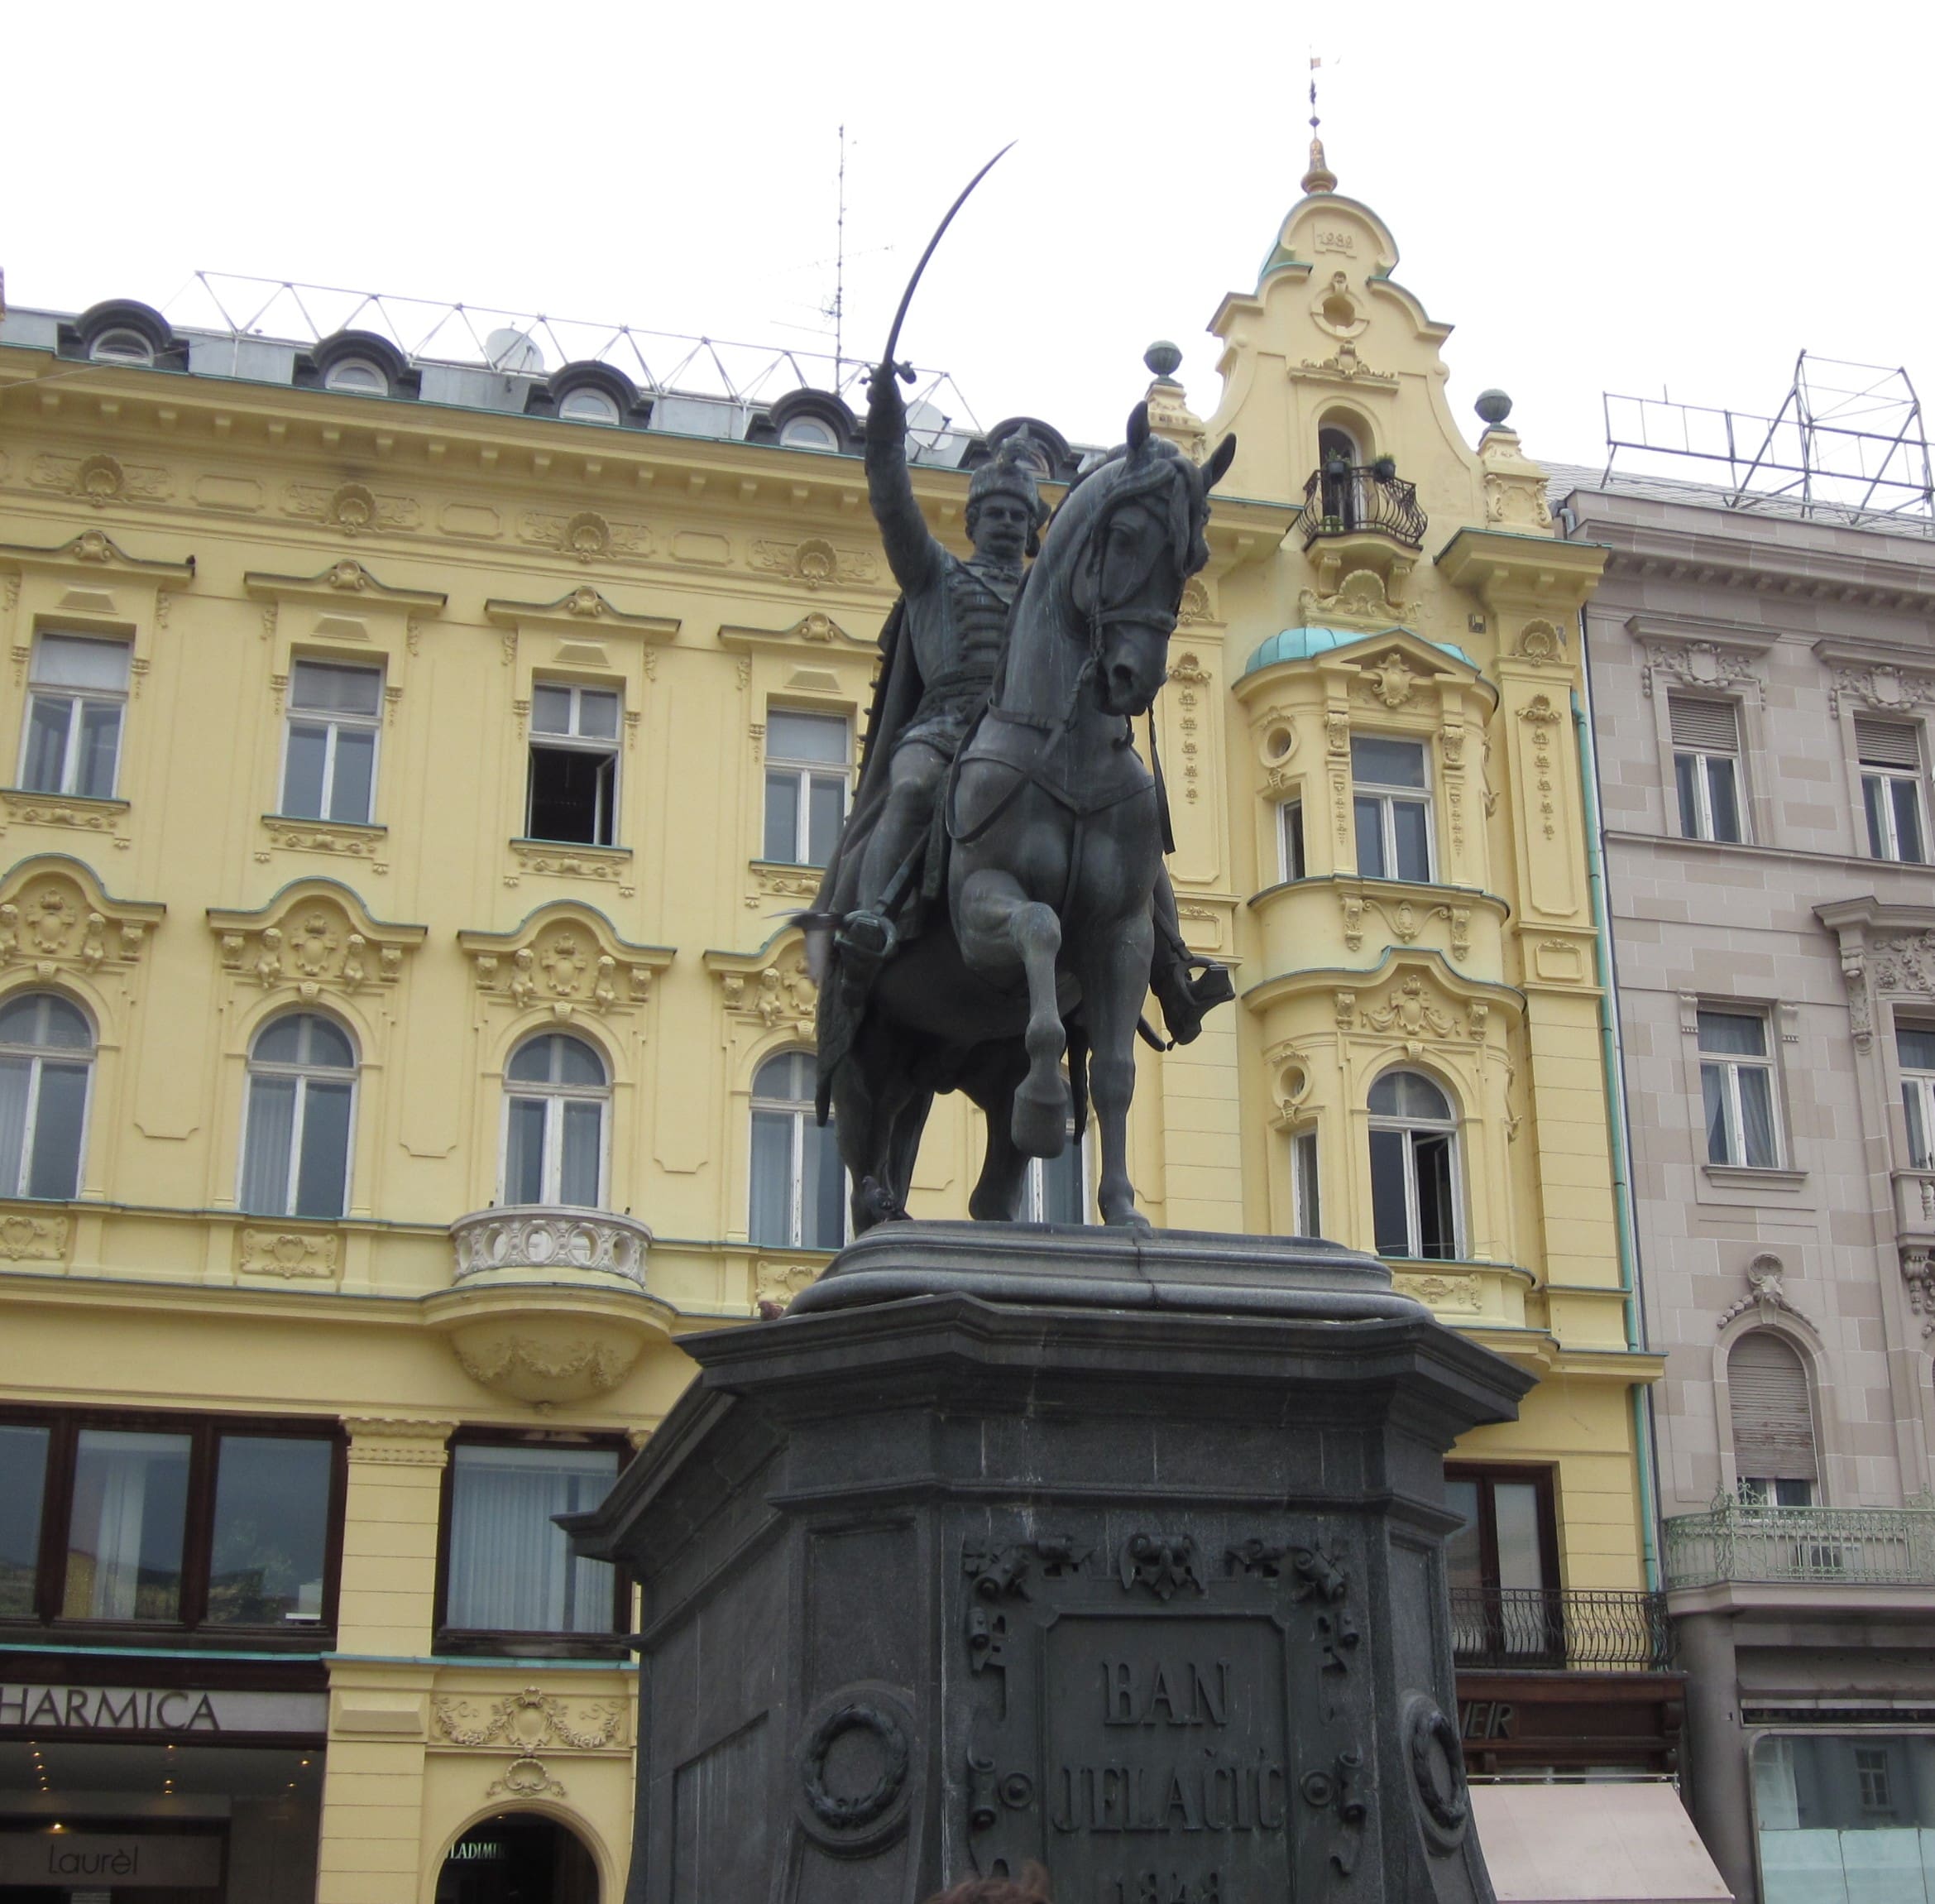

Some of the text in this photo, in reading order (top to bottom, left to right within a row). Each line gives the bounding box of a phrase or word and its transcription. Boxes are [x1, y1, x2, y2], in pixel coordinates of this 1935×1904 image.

[0, 1686, 221, 1731] HARMICA
[1101, 1660, 1230, 1726] BAN
[48, 1844, 139, 1875] Laurèl
